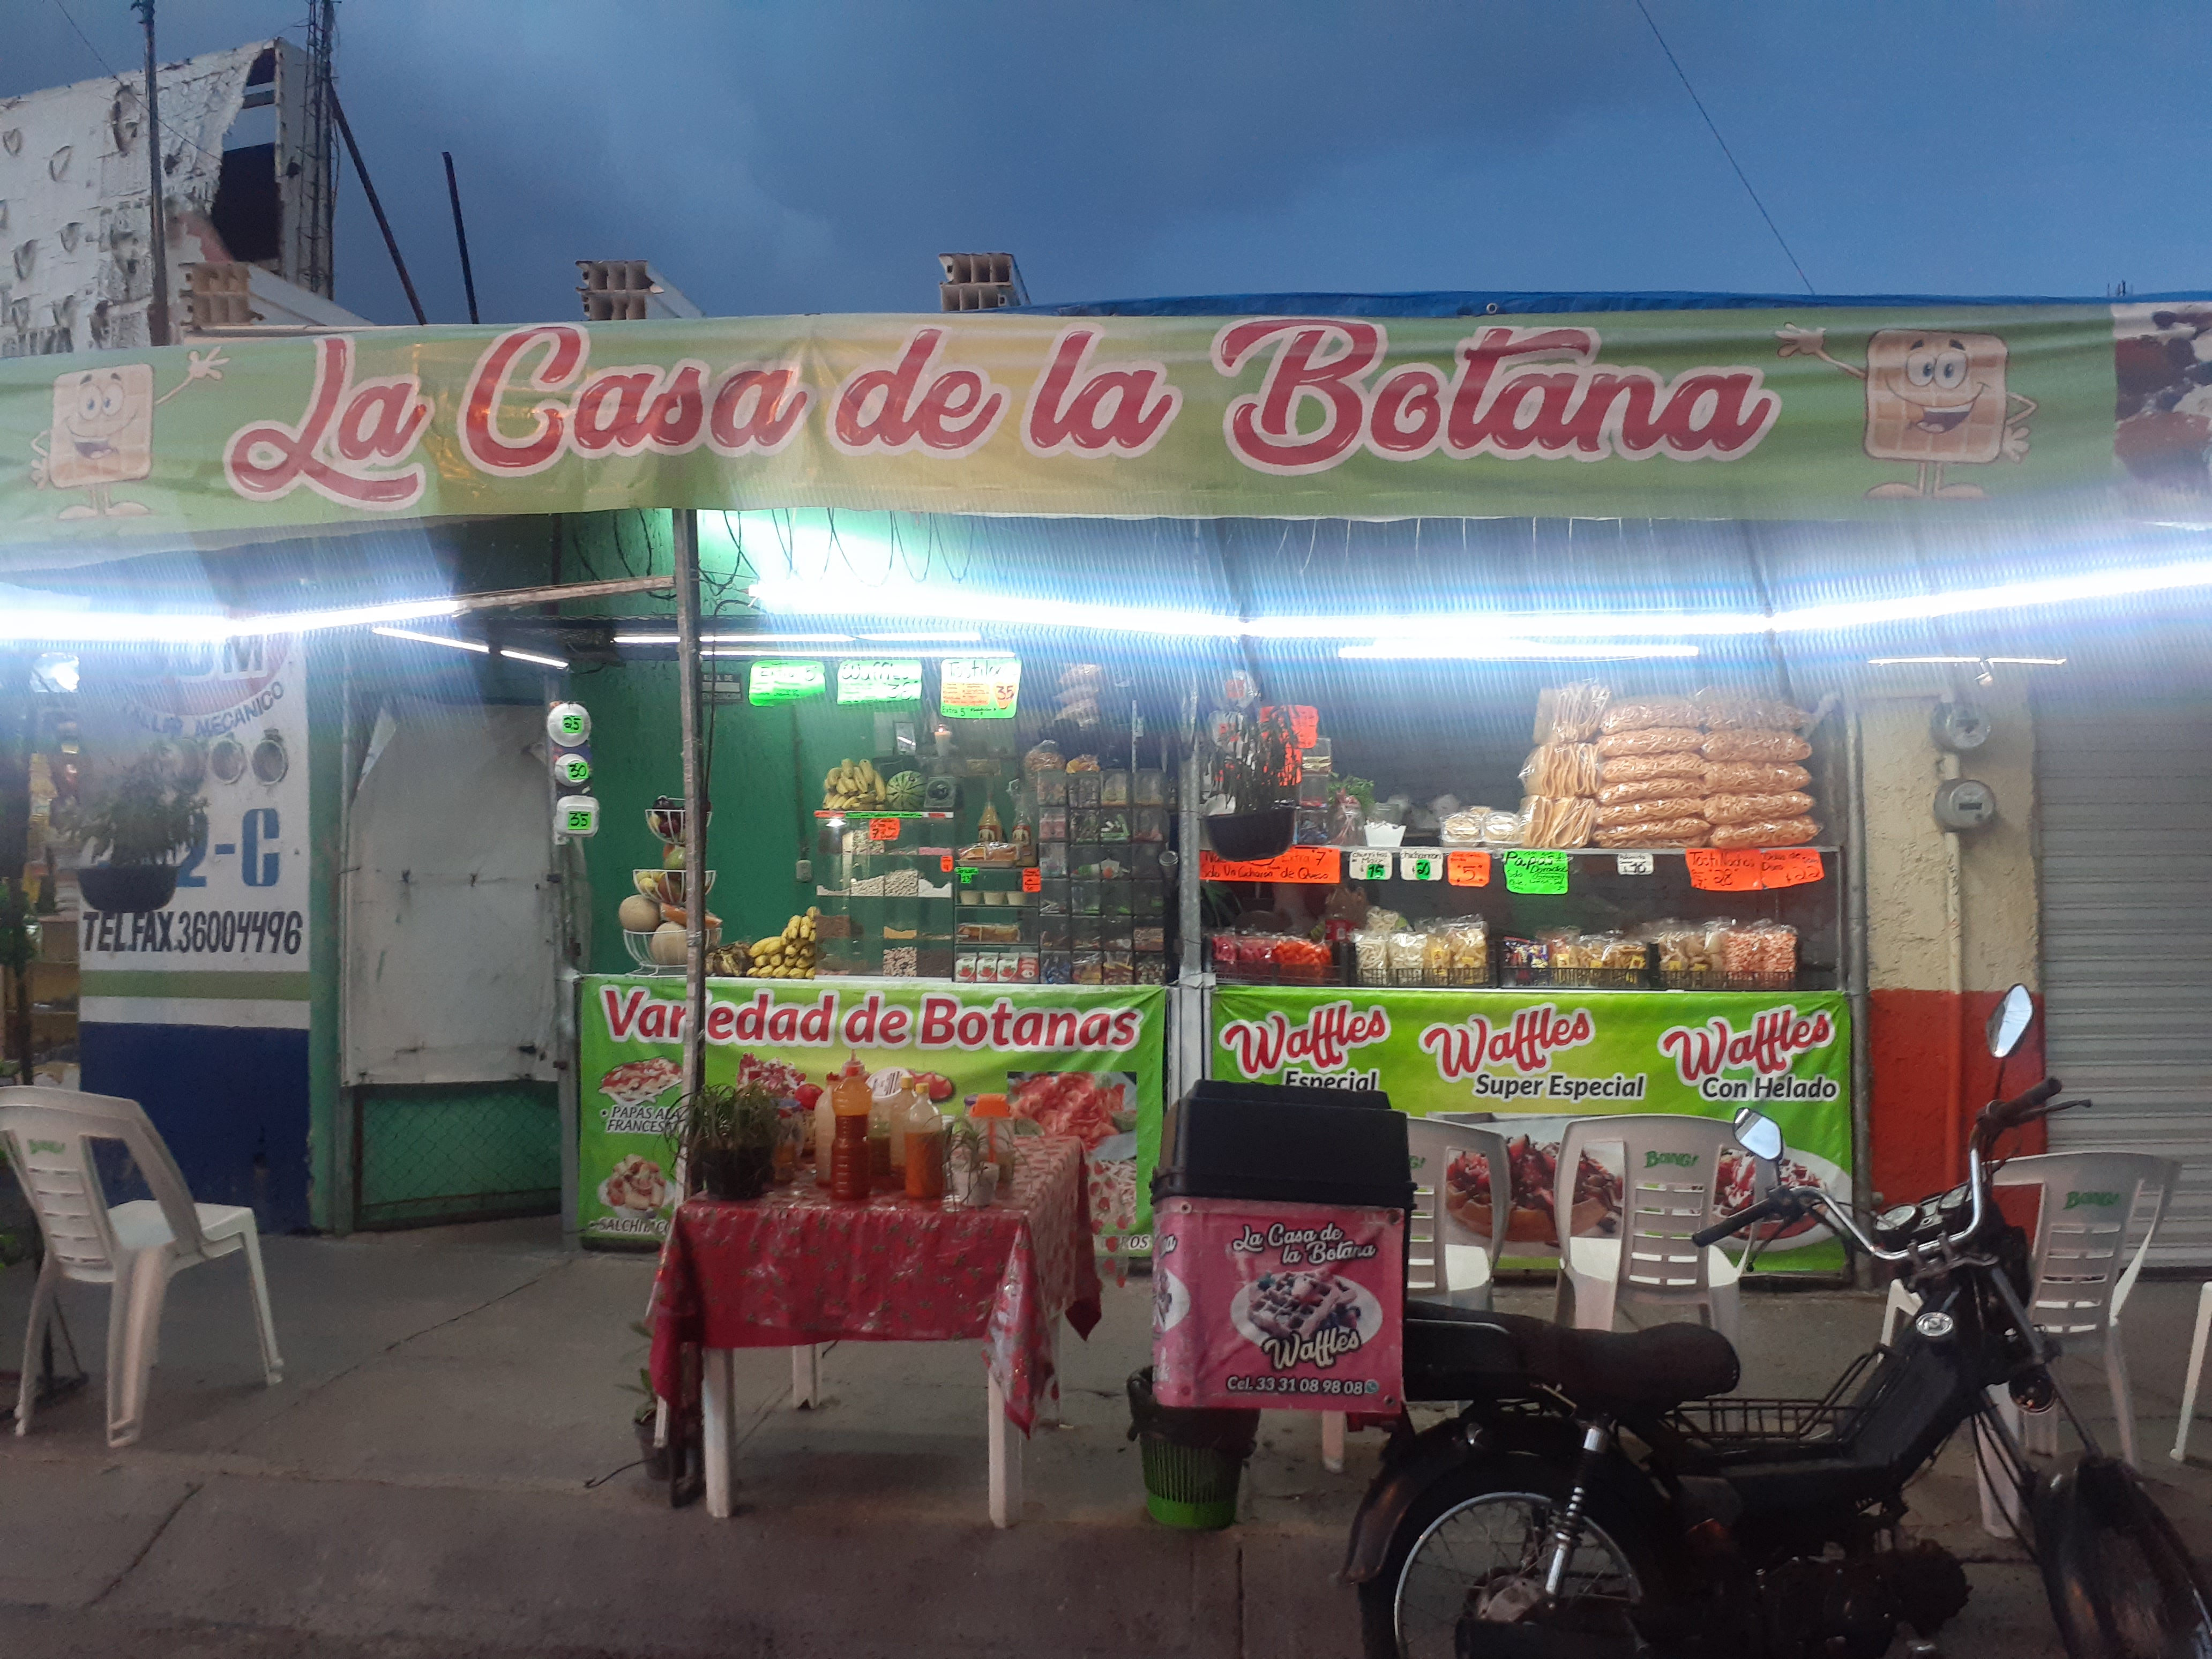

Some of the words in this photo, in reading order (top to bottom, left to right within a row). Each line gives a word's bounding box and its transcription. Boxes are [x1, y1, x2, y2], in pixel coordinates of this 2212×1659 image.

[224, 335, 433, 511] La
[460, 323, 812, 476] Casa
[827, 324, 1011, 459] de
[1021, 323, 1182, 458] la
[1212, 317, 1781, 475] Botana
[996, 685, 1014, 700] 35
[563, 716, 581, 730] 25
[569, 763, 587, 778] 30
[569, 812, 588, 826] 35
[1280, 867, 1295, 879] de
[601, 988, 835, 1045] Varedad
[843, 991, 910, 1046] de
[917, 995, 1140, 1049] Botanas
[1222, 1002, 1389, 1076] Waffles
[1422, 1005, 1592, 1079] Waffles
[1660, 1007, 1832, 1082] Waffles
[1475, 1073, 1543, 1100] Super
[1549, 1074, 1645, 1100] Especial
[1702, 1077, 1747, 1099] Con
[1754, 1076, 1836, 1099] Helado
[611, 1106, 653, 1118] PAPAS
[1232, 1225, 1264, 1252] La
[1267, 1223, 1317, 1247] Casa
[1319, 1222, 1343, 1241] de
[1281, 1244, 1302, 1264] la
[1306, 1240, 1377, 1264] Botana
[1264, 1329, 1361, 1370] Waffles
[1227, 1376, 1253, 1390] Cel.
[1256, 1376, 1275, 1391] 33
[1278, 1377, 1296, 1392] 31
[1299, 1378, 1319, 1393] 08
[1322, 1379, 1340, 1393] 98
[1344, 1380, 1363, 1394] 08
